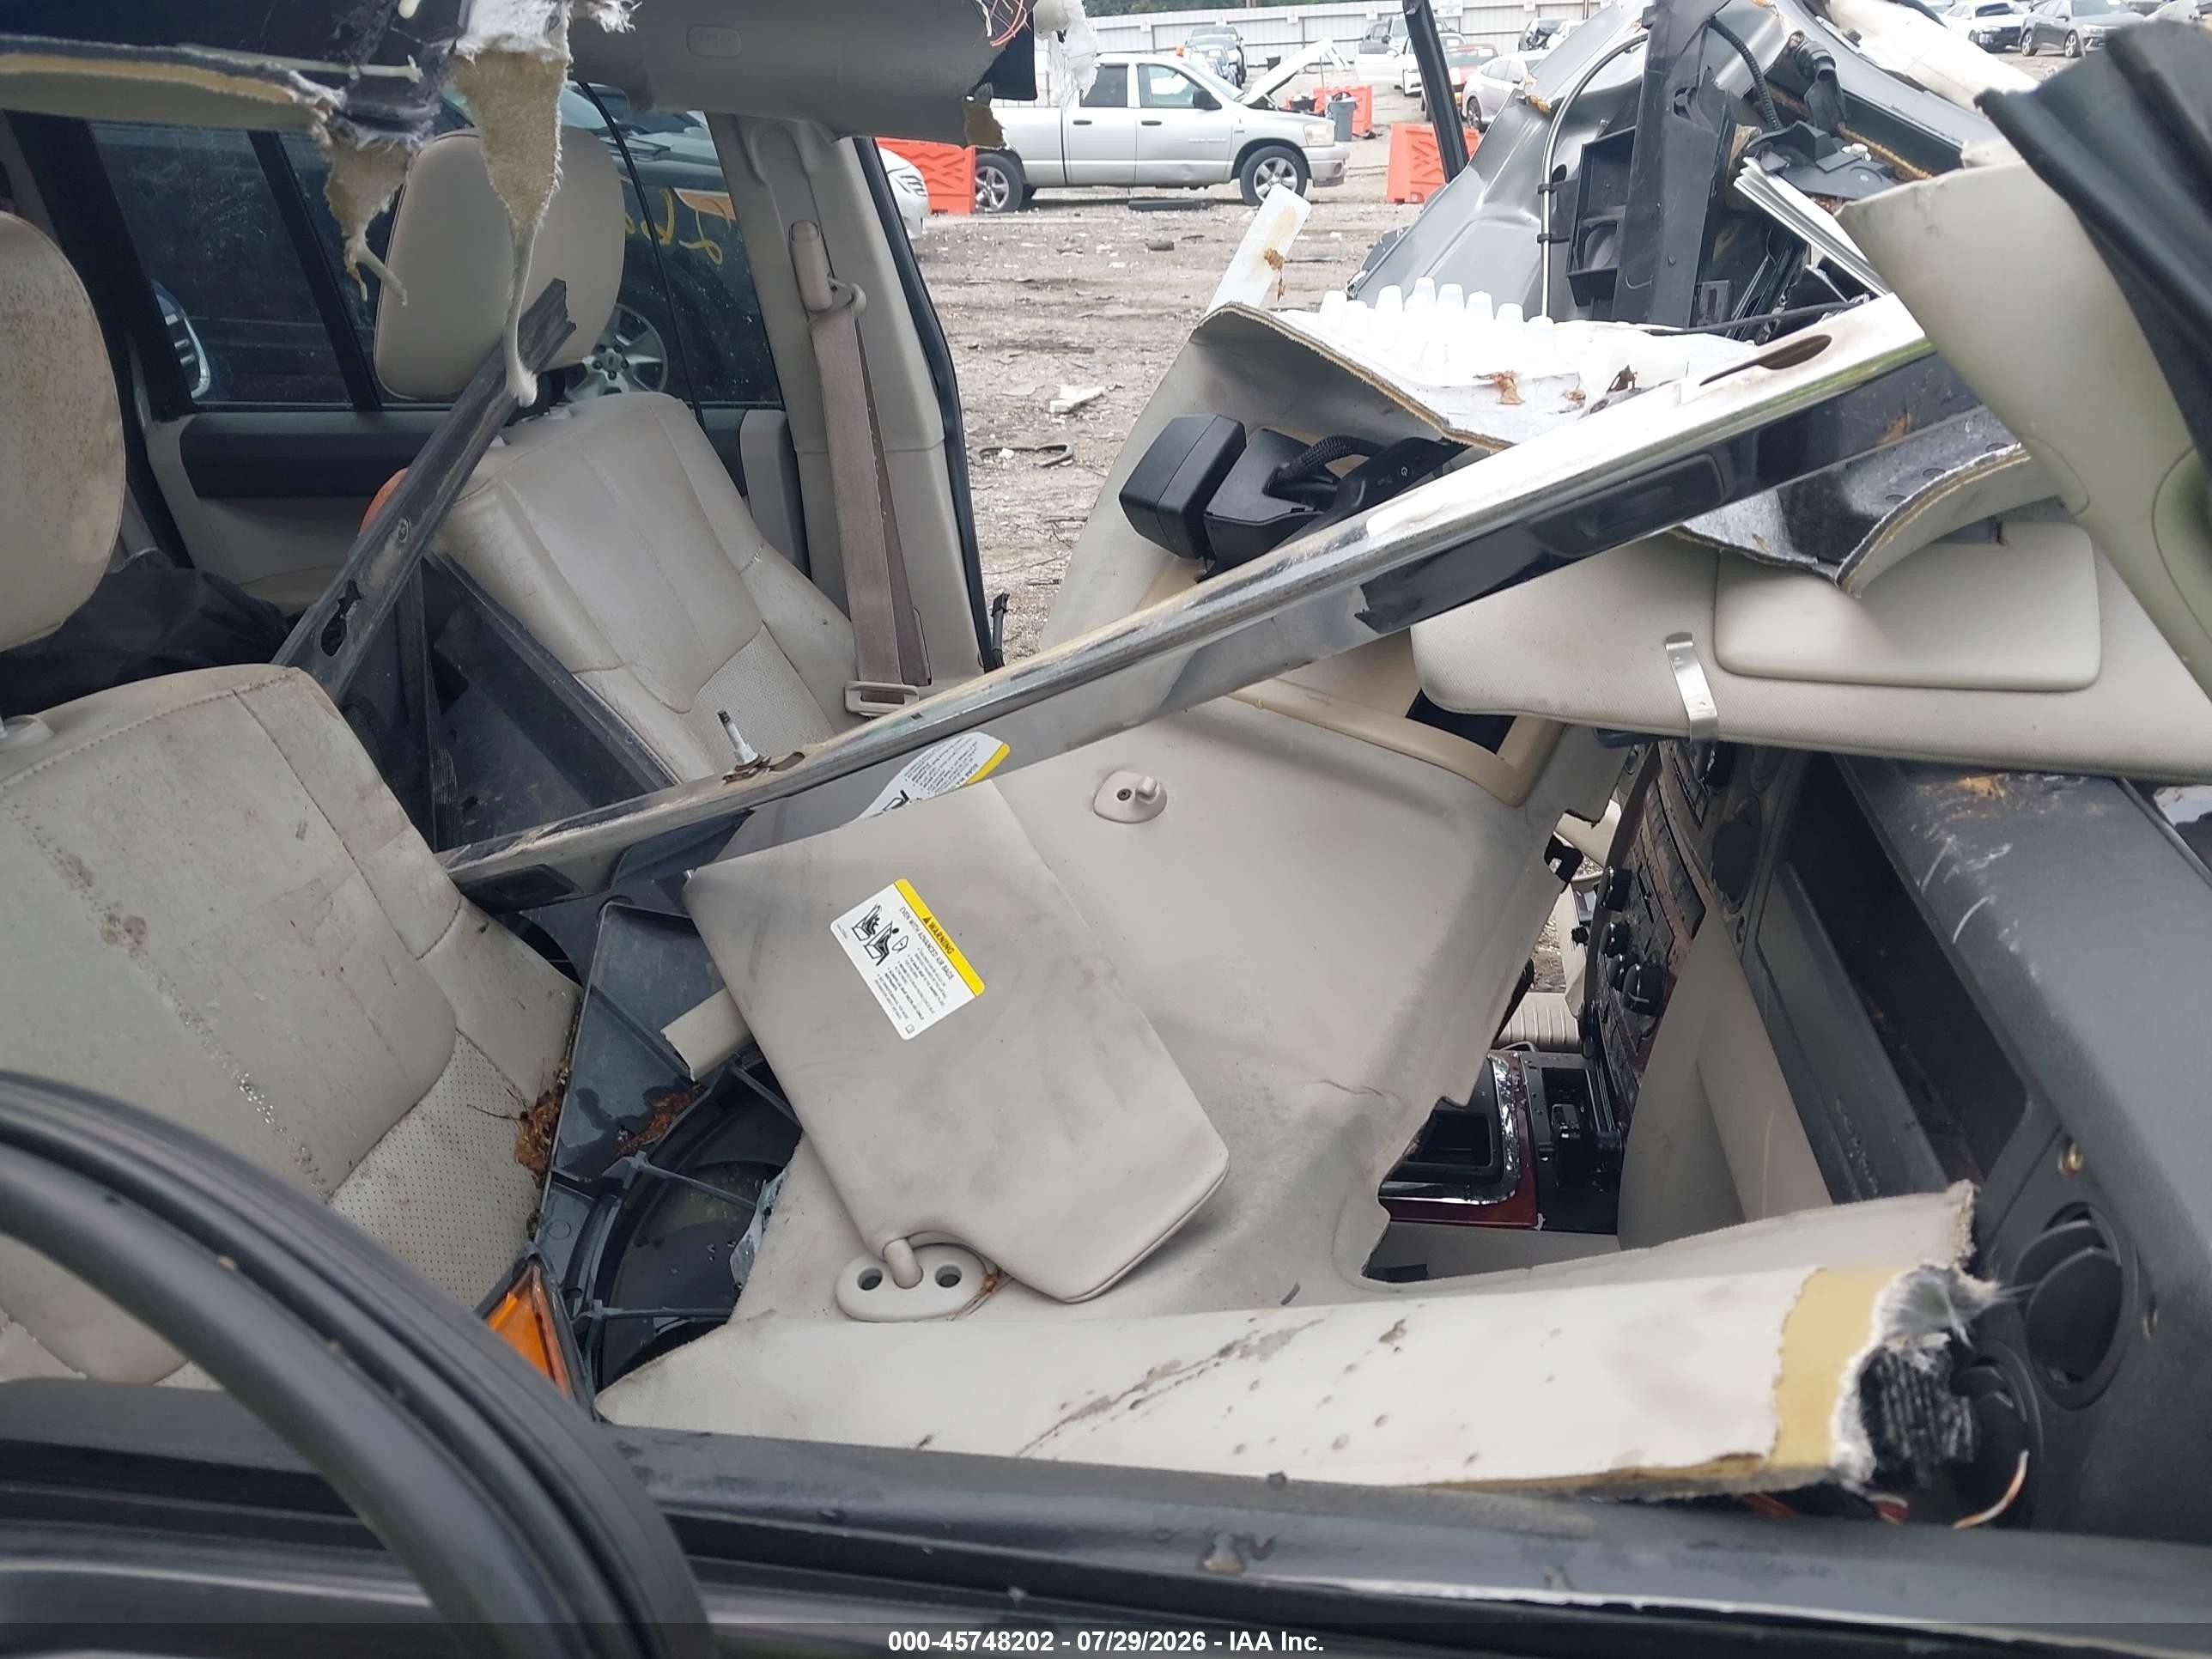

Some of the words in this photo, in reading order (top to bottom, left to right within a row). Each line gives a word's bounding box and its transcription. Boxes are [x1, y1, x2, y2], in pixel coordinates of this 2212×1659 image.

[899, 906, 911, 920] EVEN
[916, 930, 939, 957] ADVANCED
[935, 956, 945, 965] AIR
[941, 964, 955, 979] BAGS
[927, 921, 954, 954] WARNING
